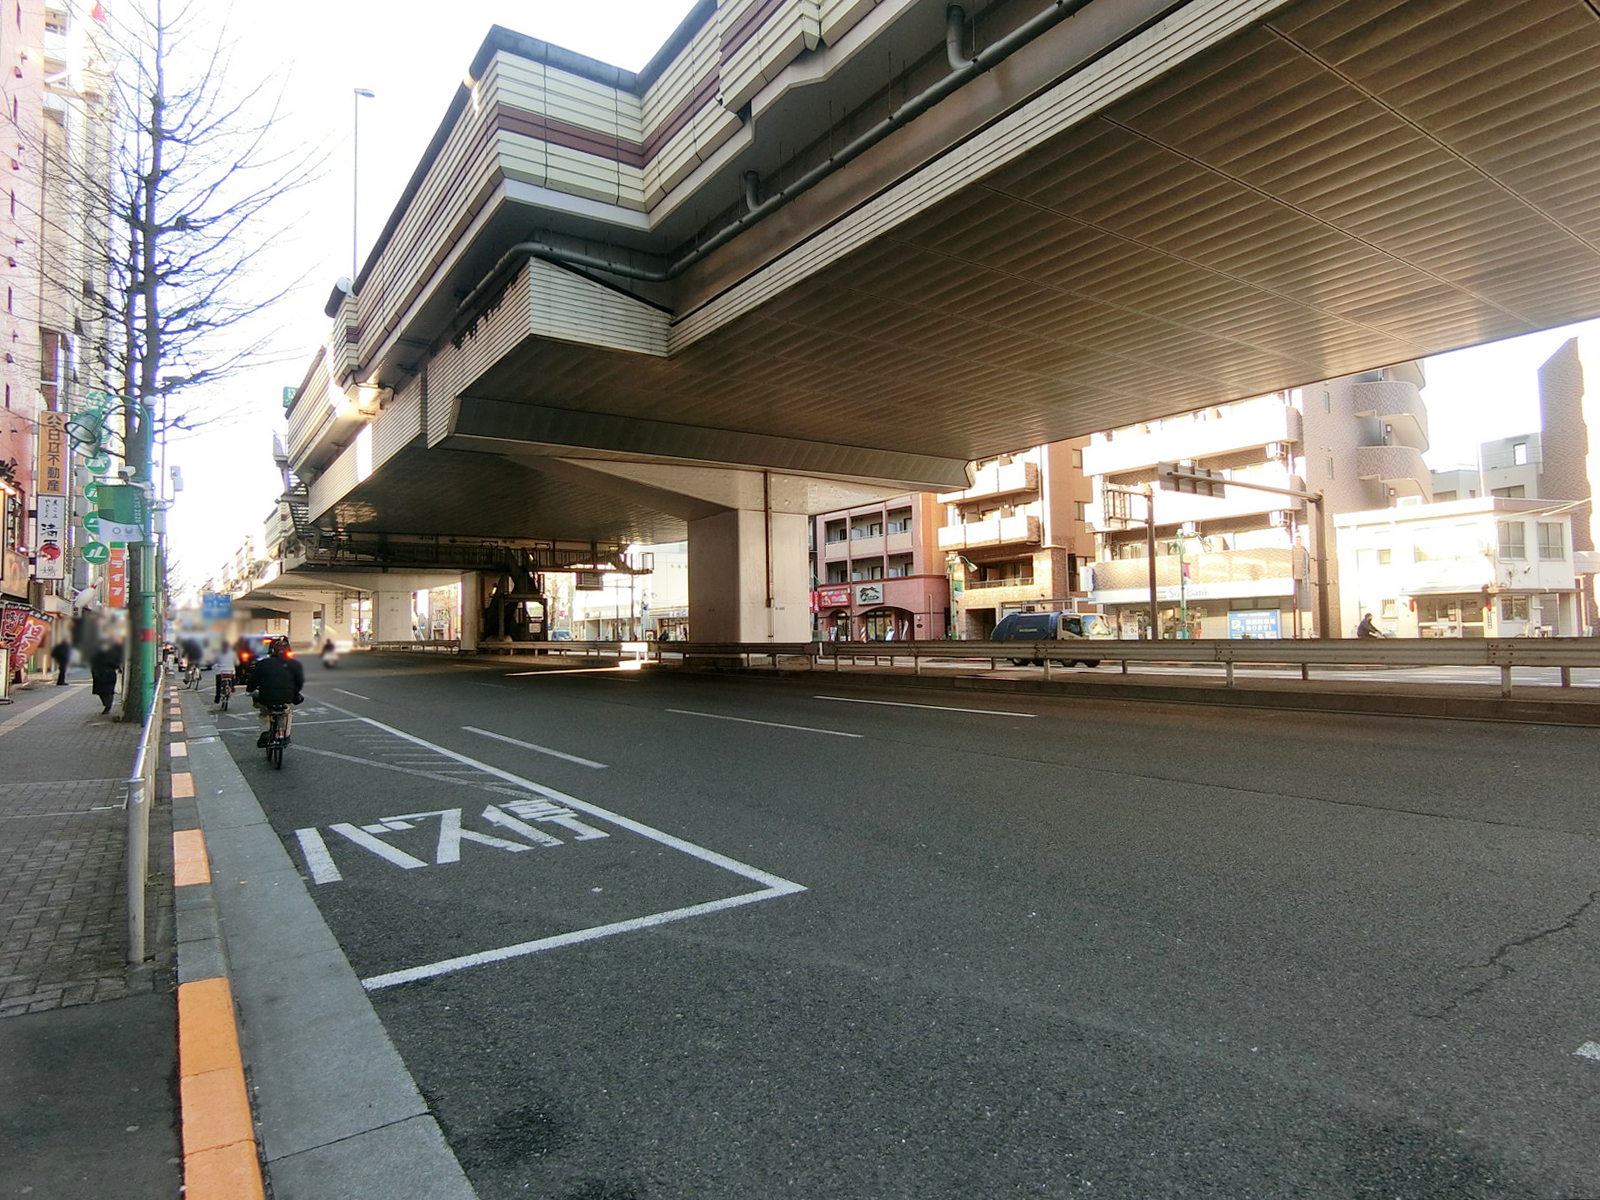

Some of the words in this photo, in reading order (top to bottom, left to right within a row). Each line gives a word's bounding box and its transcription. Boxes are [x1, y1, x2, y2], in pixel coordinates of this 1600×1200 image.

[40, 523, 61, 577] 満天場
[111, 560, 124, 596] ライフ
[1168, 587, 1210, 598] SoBank
[294, 798, 610, 886] バス停
